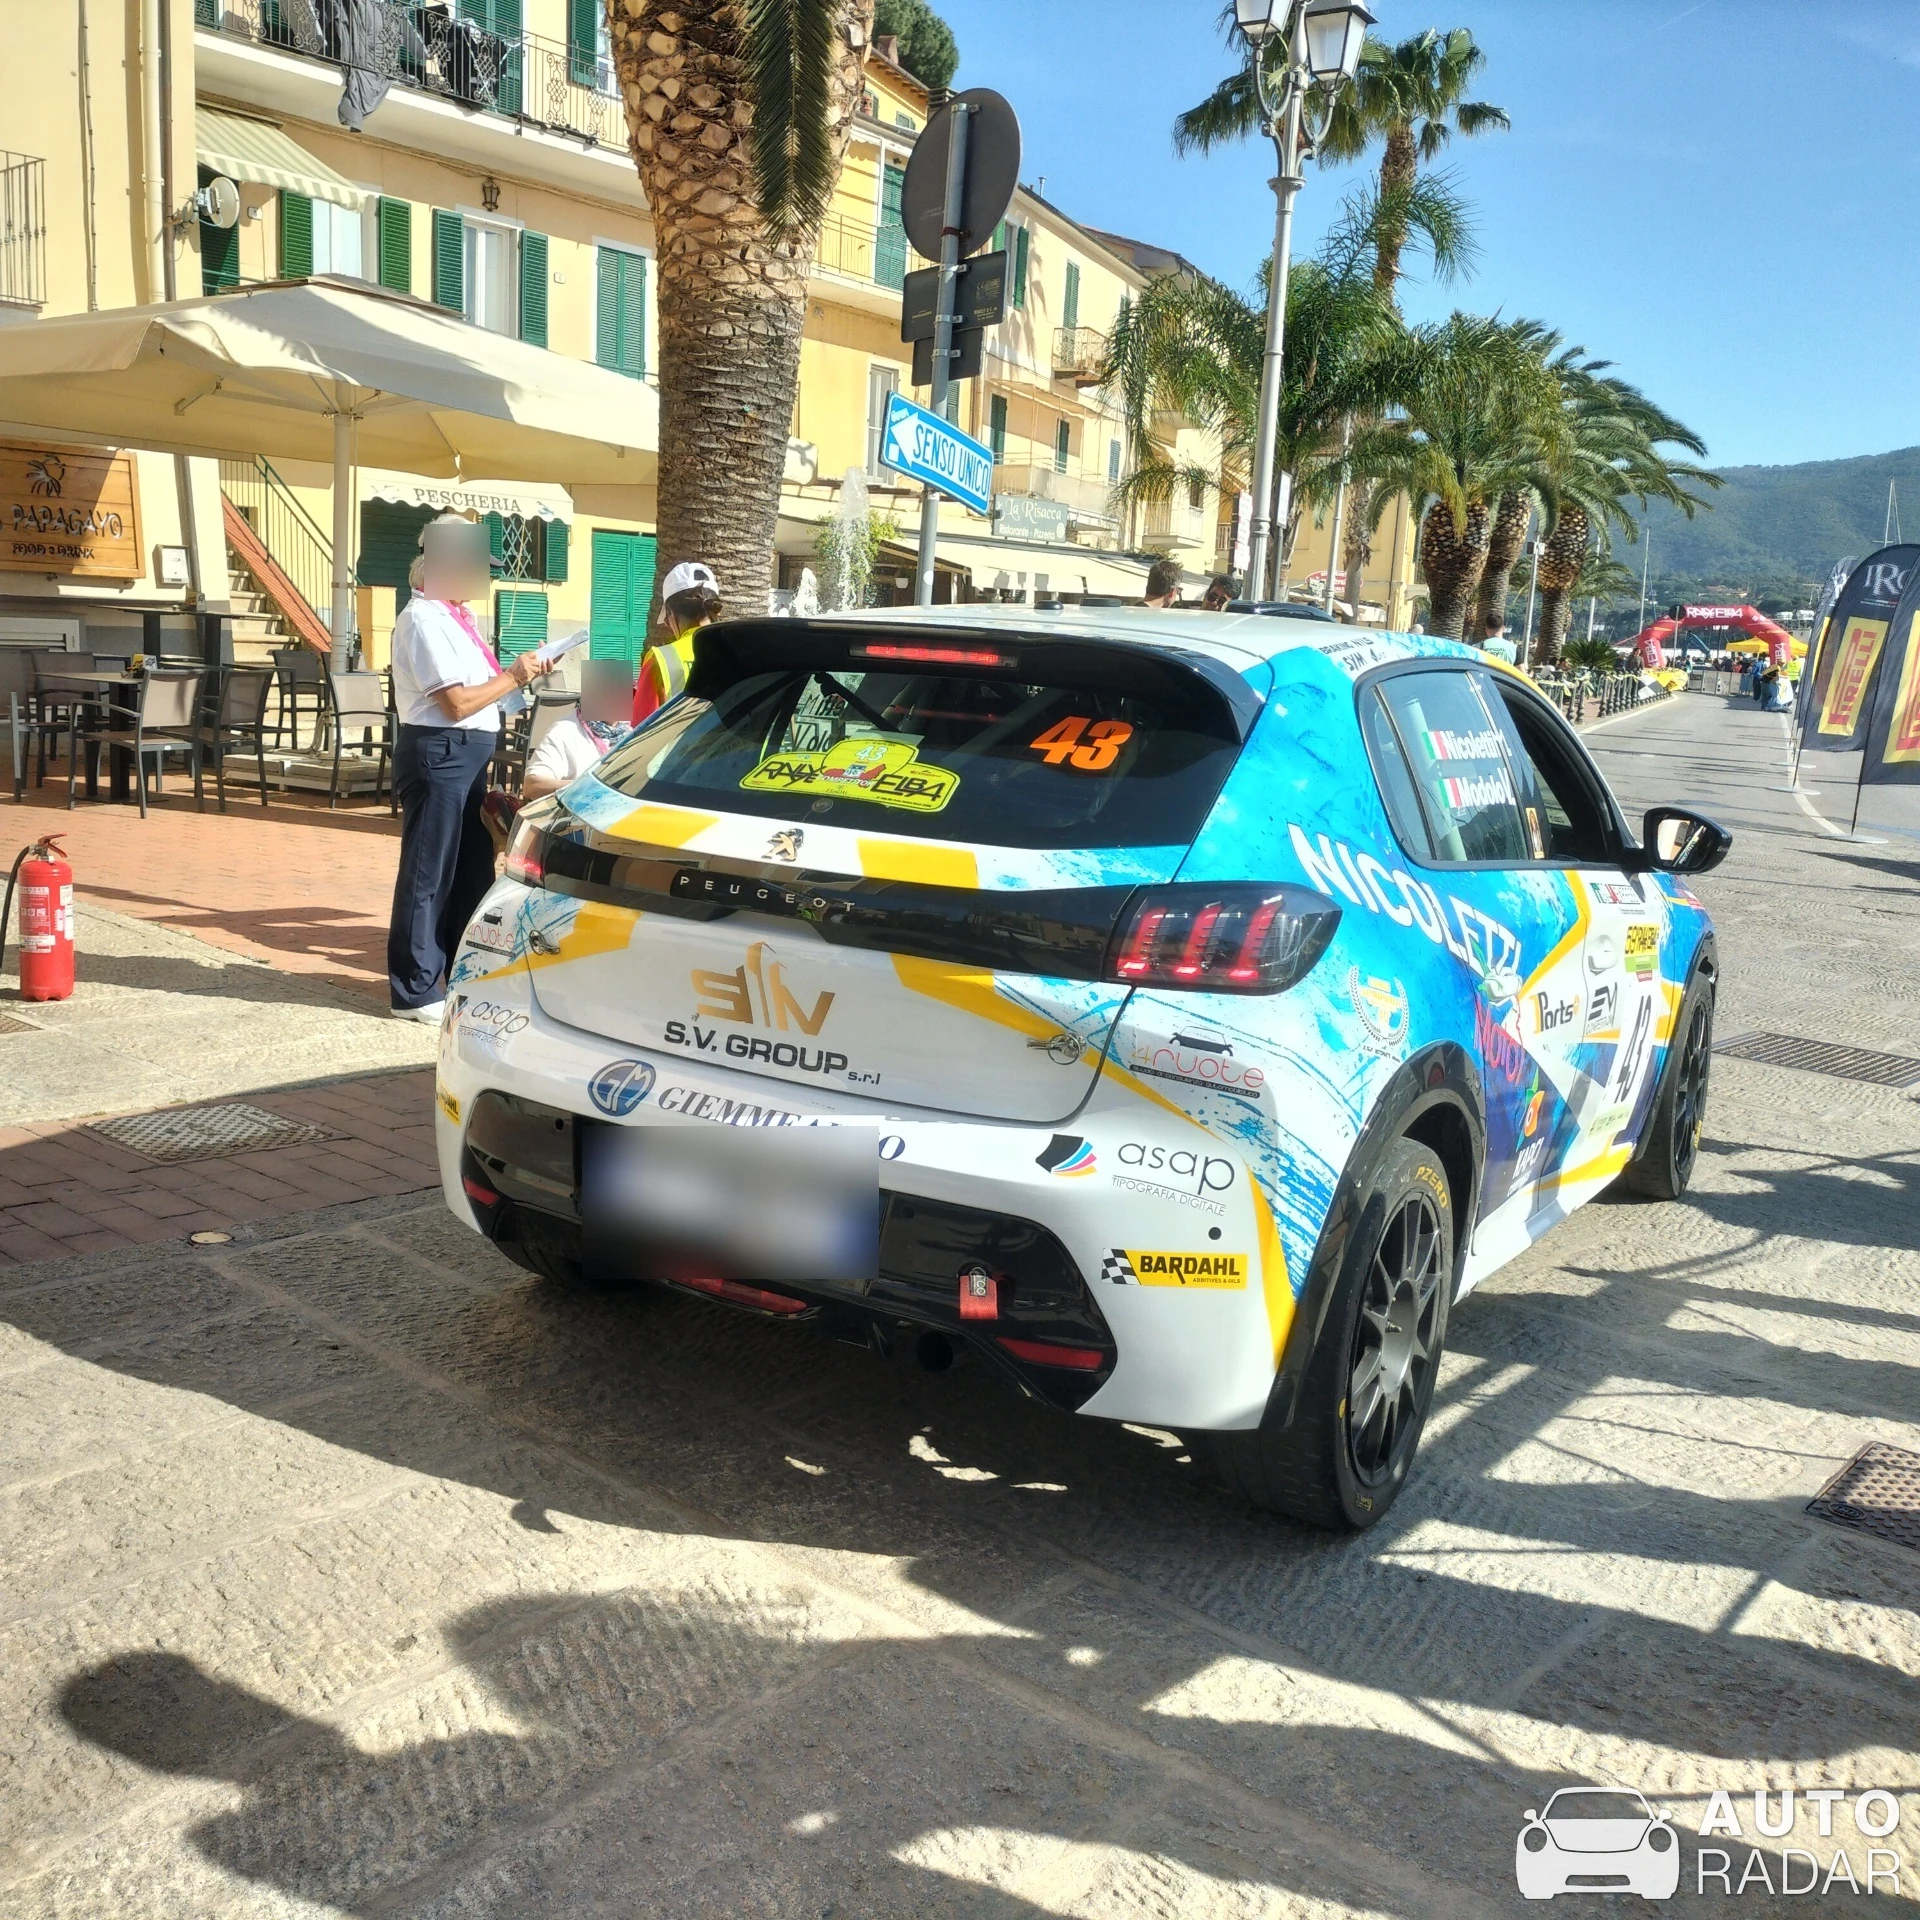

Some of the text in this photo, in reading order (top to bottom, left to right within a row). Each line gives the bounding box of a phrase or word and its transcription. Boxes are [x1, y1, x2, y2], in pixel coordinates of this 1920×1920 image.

[913, 424, 989, 497] SENSO UNICO
[413, 488, 522, 512] PESCHERIA
[1005, 498, 1062, 524] La Risacca
[11, 504, 123, 539] PAPAGAYO
[999, 524, 1029, 537] Ristorante
[1034, 528, 1055, 540] Pizzeria
[13, 543, 46, 556] FOOD
[1343, 652, 1368, 671] SYM
[1828, 628, 1877, 725] PIRELLI
[856, 745, 889, 761] 43
[1028, 716, 1134, 770] 43
[1442, 731, 1498, 760] Nicoletti
[1457, 774, 1501, 807] Modolo
[680, 876, 855, 912] PEUGEOT
[1287, 822, 1523, 978] NICOLETTI
[471, 1001, 530, 1036] asap
[664, 1021, 717, 1052] S.V.
[725, 1034, 848, 1074] GROUP
[1614, 994, 1652, 1104] 43
[1131, 1045, 1264, 1088] 4ruote
[1165, 1072, 1204, 1086] consulenza
[1205, 1081, 1258, 1098] automobilistica
[1118, 1143, 1235, 1195] asap
[1112, 1177, 1227, 1216] TIPOGRAFIA DIGITALE
[1139, 1255, 1240, 1285] BARDAHL
